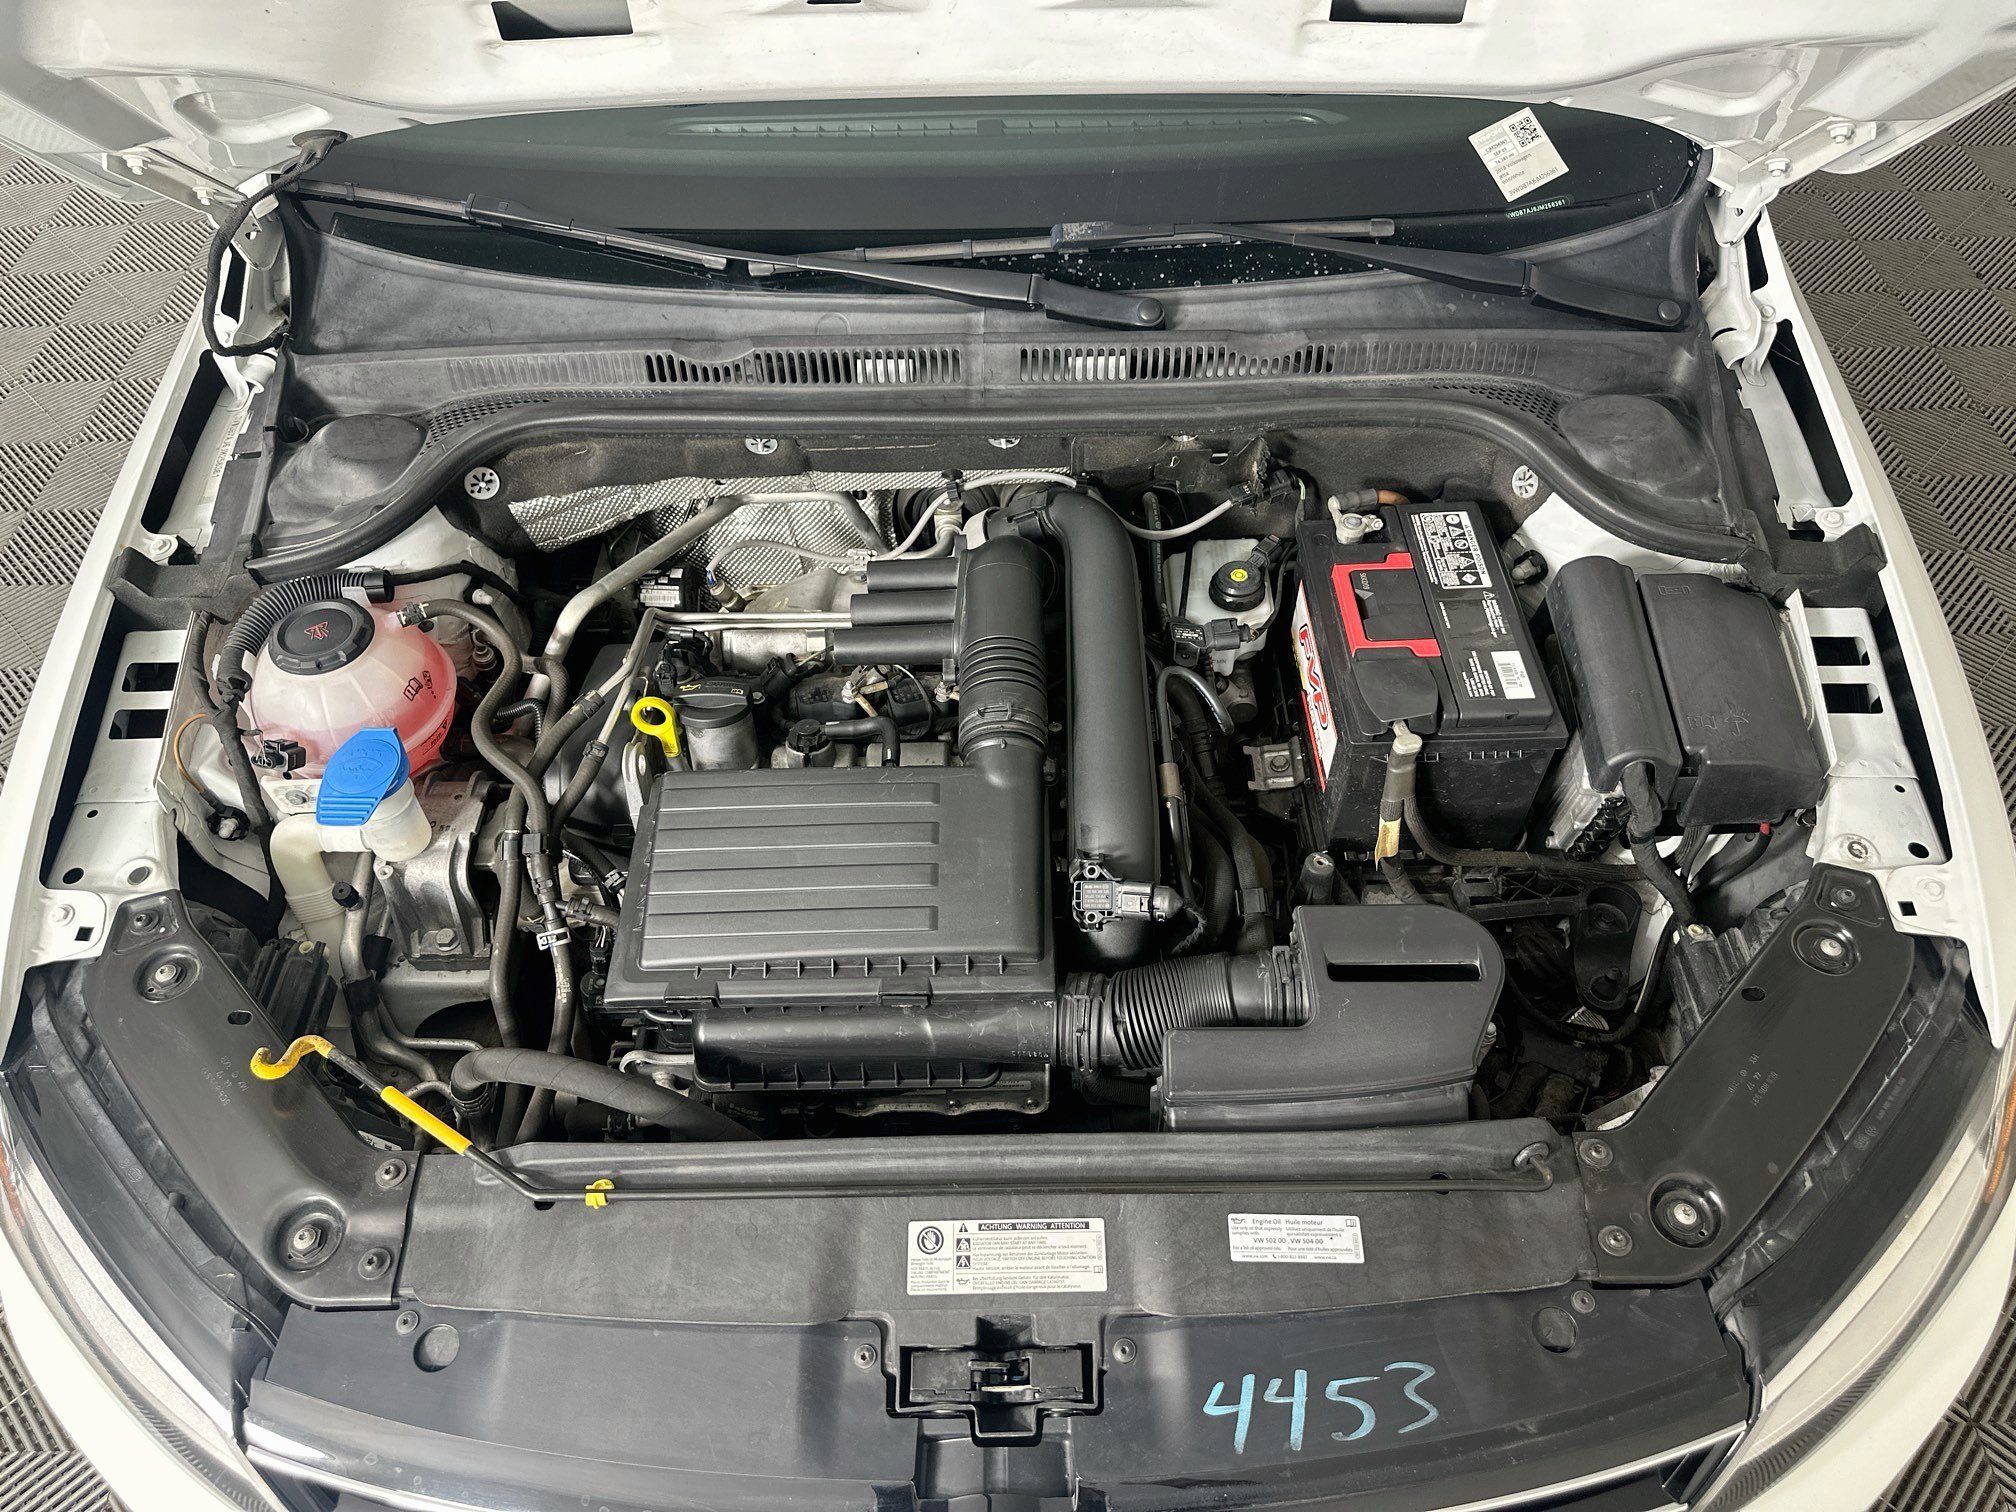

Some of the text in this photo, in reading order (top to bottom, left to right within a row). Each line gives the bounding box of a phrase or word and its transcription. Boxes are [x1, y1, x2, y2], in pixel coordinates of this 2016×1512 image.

[1467, 530, 1486, 575] DANGER POISON
[1299, 623, 1328, 730] FVP
[1015, 1222, 1047, 1230] WARNING
[1252, 1218, 1271, 1226] Engine
[1203, 1361, 1440, 1455] 4453
